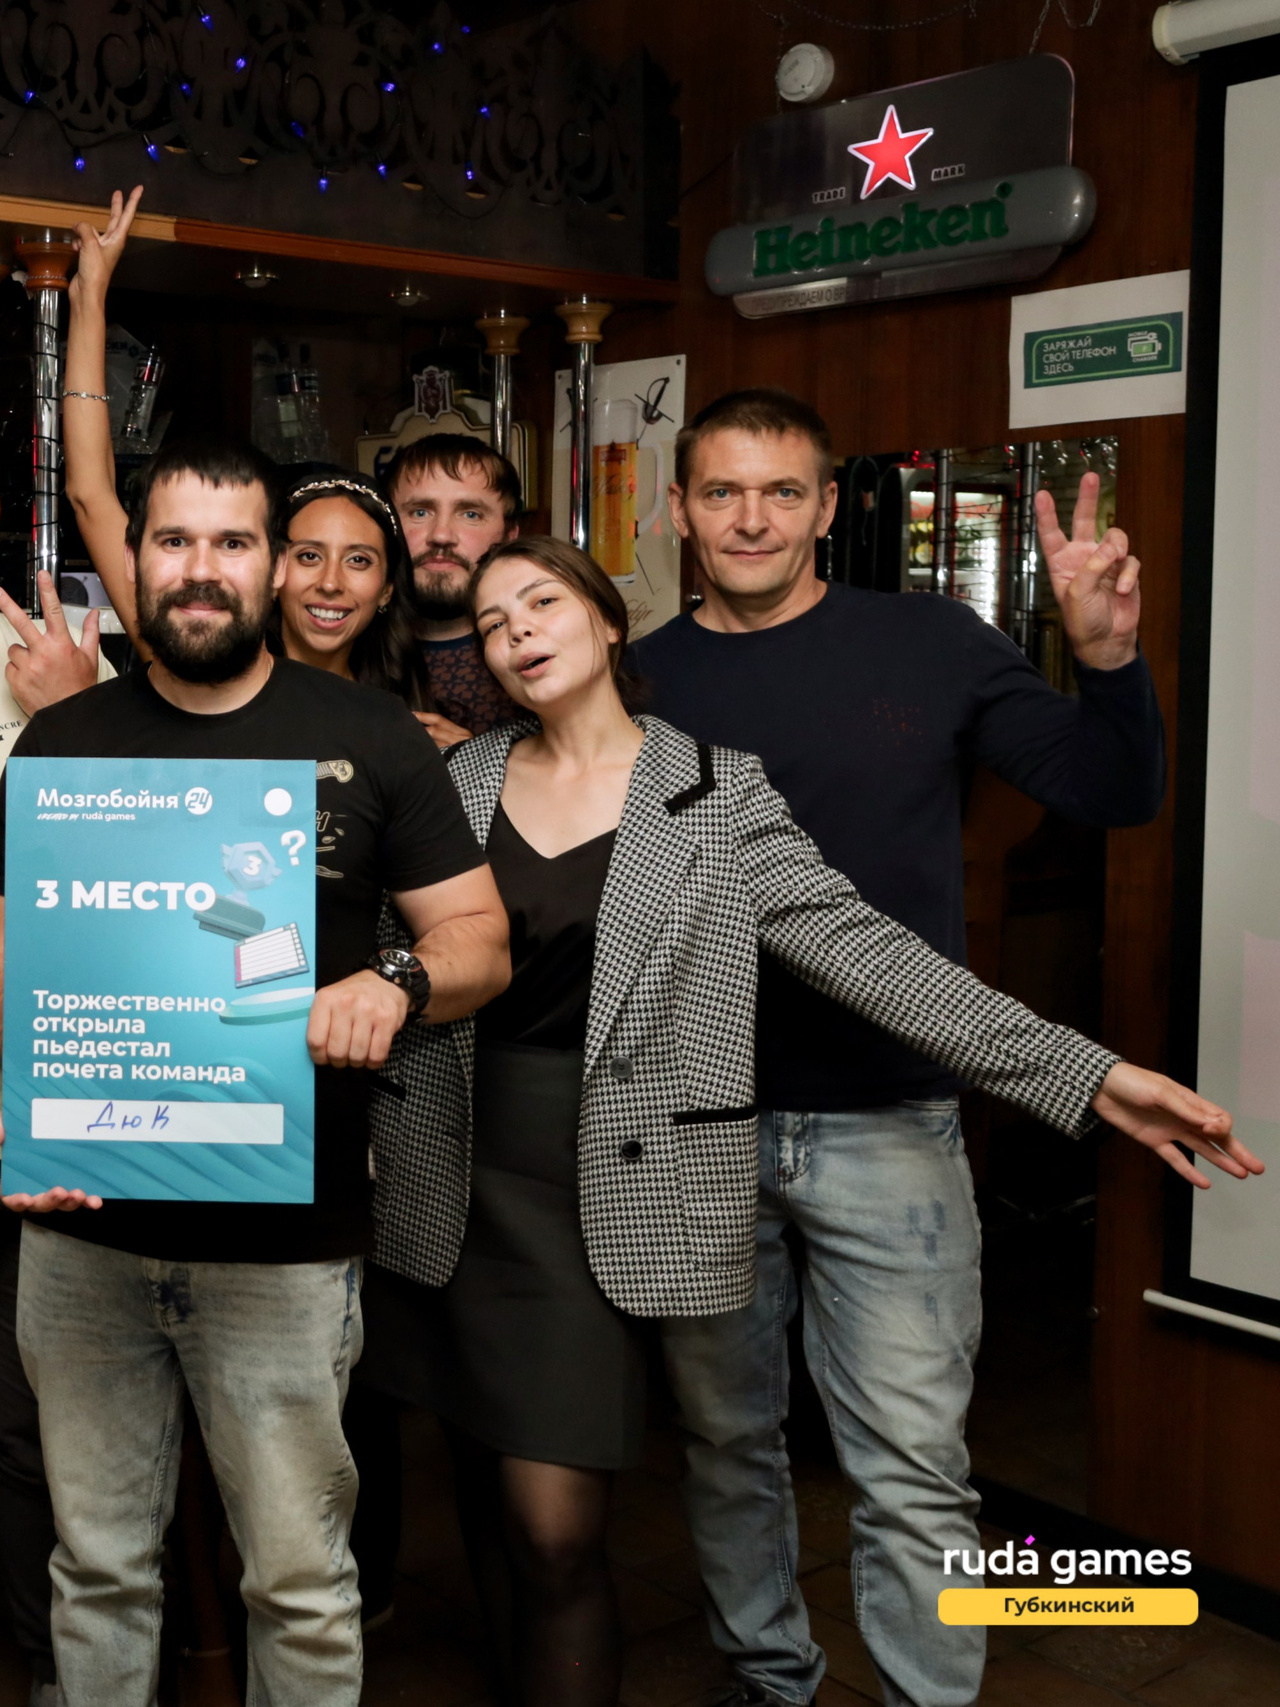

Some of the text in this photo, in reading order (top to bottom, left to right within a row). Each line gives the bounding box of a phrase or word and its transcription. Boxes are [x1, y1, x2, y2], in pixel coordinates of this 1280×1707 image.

[812, 164, 965, 204] TRADE MARK
[753, 196, 1010, 277] Heineken
[1043, 336, 1092, 353] ЗАРЯЖАЙ
[1043, 346, 1117, 364] СВОЙ ТЕЛЕФОН
[1043, 364, 1074, 375] ЗДЕСЬ
[37, 788, 179, 809] Мозгобойня
[105, 813, 136, 822] games
[35, 880, 217, 911] 3 МЕСТО
[33, 989, 227, 1013] Торжественно
[33, 1015, 146, 1035] открыла
[32, 1038, 171, 1060] пьедестал
[32, 1063, 247, 1085] почета команда
